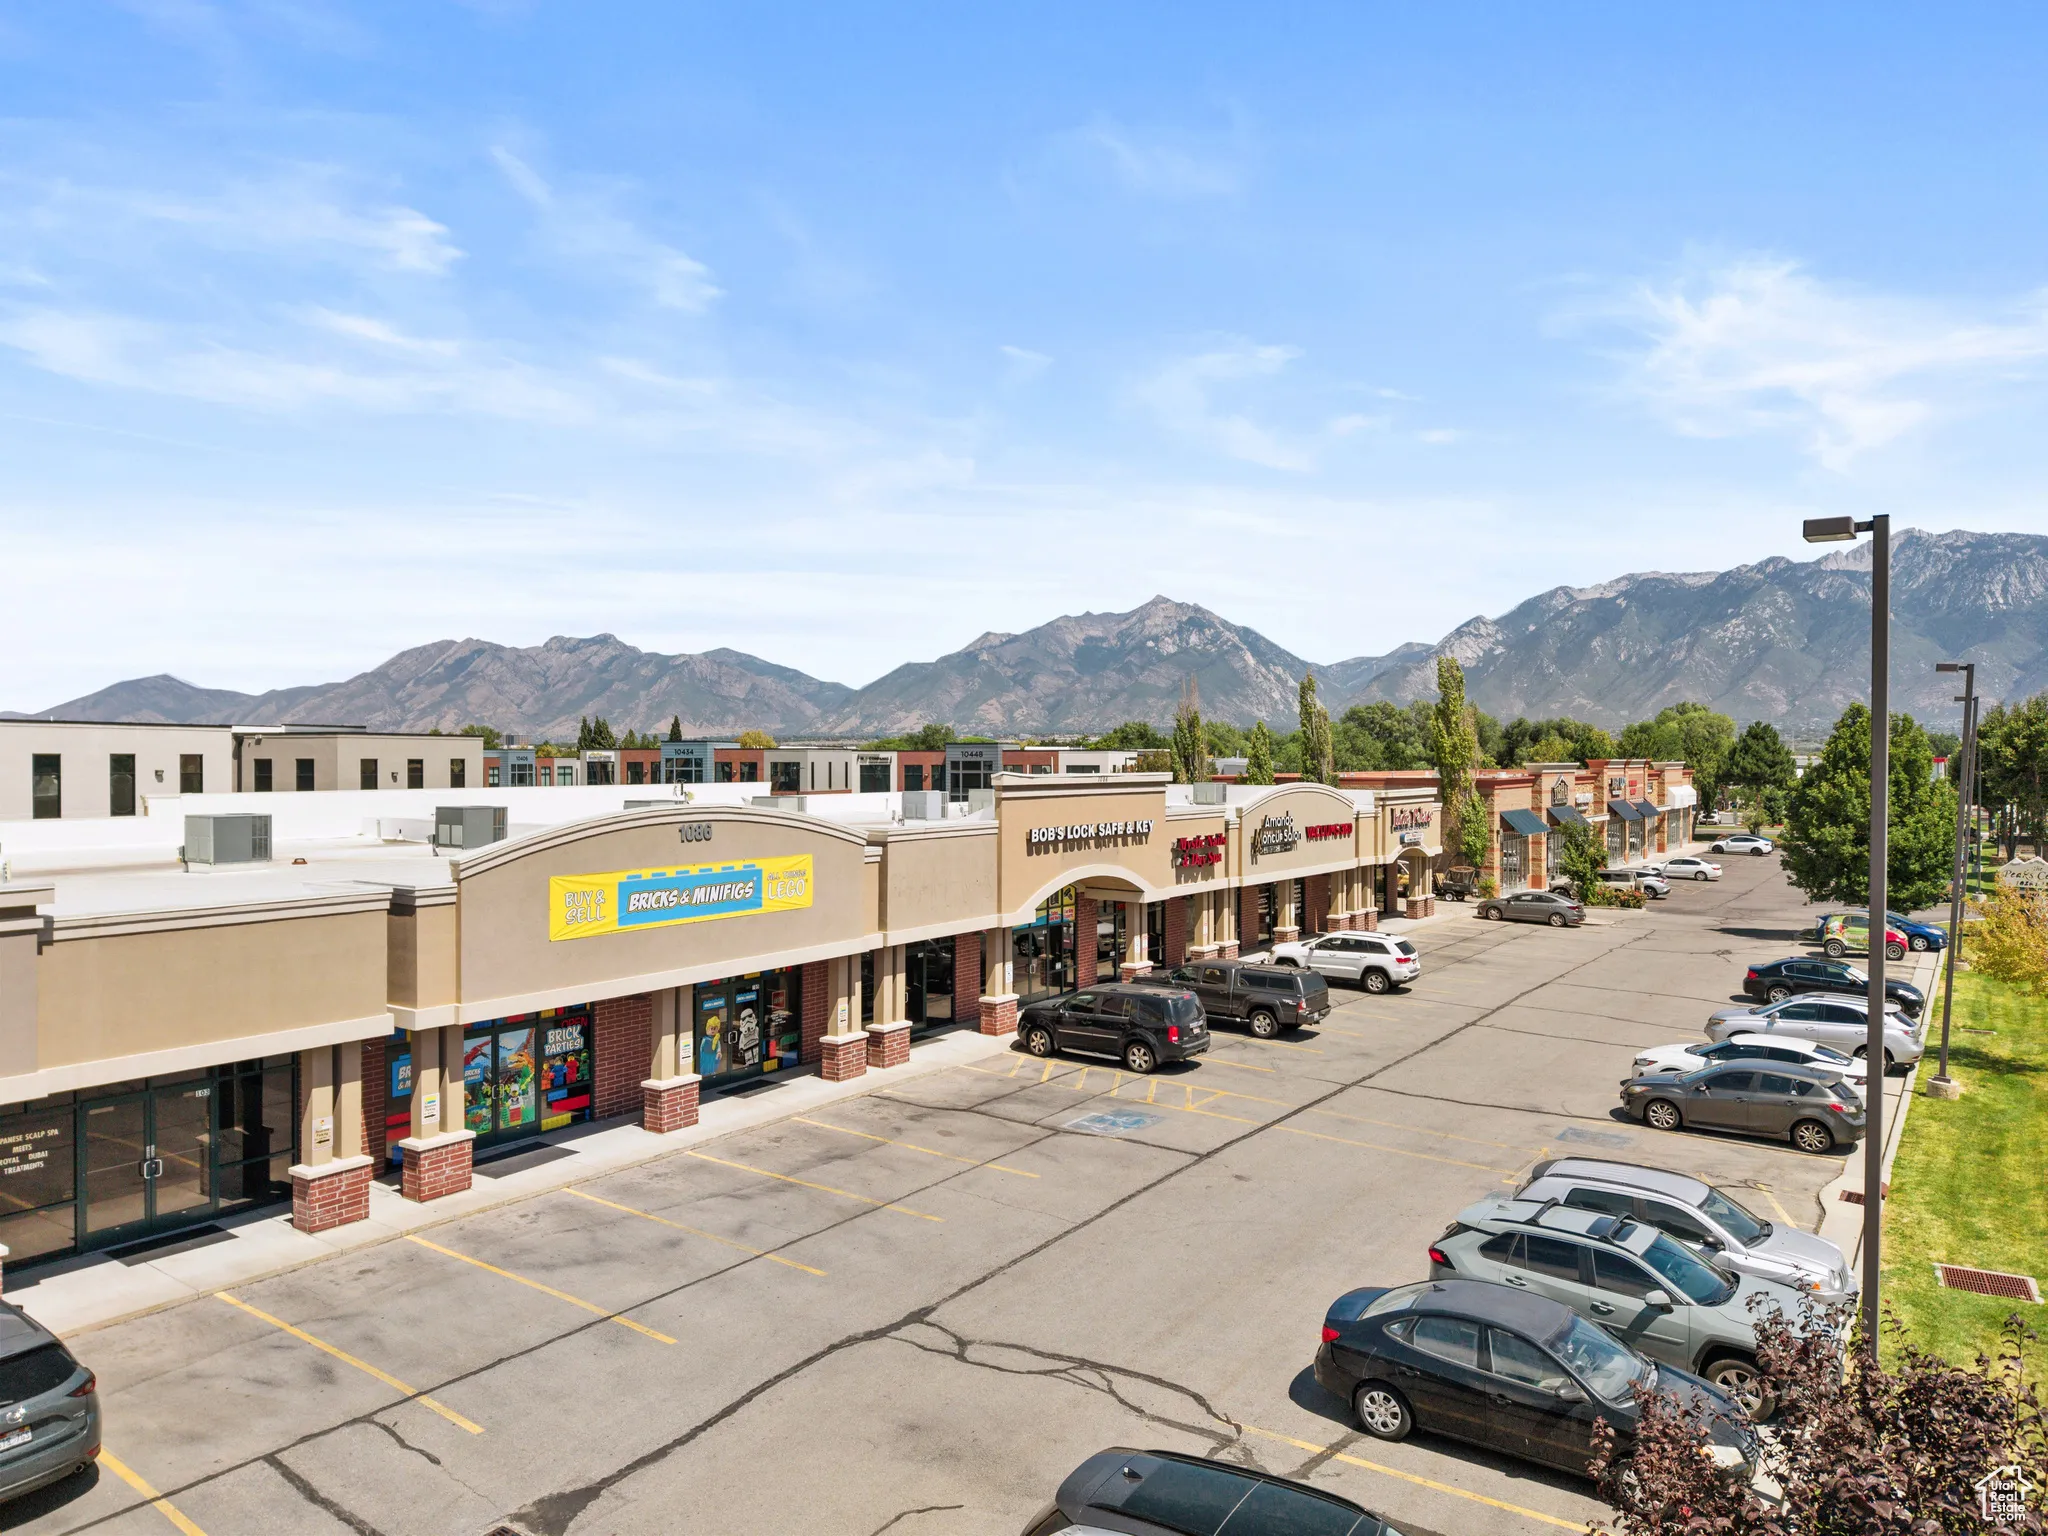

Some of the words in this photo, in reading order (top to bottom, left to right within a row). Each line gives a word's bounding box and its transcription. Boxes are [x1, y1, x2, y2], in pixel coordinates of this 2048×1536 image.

[674, 748, 694, 756] 10434
[960, 750, 984, 758] 10448
[678, 823, 713, 843] 1086
[1030, 826, 1065, 843] BOB'S
[1067, 824, 1096, 840] LOCK
[1099, 822, 1124, 837] SAFE
[1126, 820, 1134, 834] &
[1136, 819, 1155, 833] KEY
[1205, 833, 1227, 847] Nails
[1190, 853, 1206, 868] Day
[1207, 852, 1222, 866] Spa
[767, 872, 780, 881] ALL
[783, 869, 807, 879] THINGS
[627, 889, 679, 913] BRICKS
[680, 889, 691, 905] &
[692, 880, 755, 905] MINIFIGS
[767, 878, 806, 900] LEGO
[564, 890, 593, 908] BUY
[594, 889, 605, 904] &
[565, 905, 605, 925] SELL
[561, 1015, 589, 1028] OPEN
[547, 1026, 581, 1044] BRICK
[545, 1038, 584, 1056] PARTIES!
[25, 1130, 46, 1141] SCALP
[47, 1128, 59, 1137] SPA
[12, 1143, 33, 1154] MEETS
[28, 1150, 48, 1160] DUBAI
[4, 1161, 45, 1175] TREATMENTS
